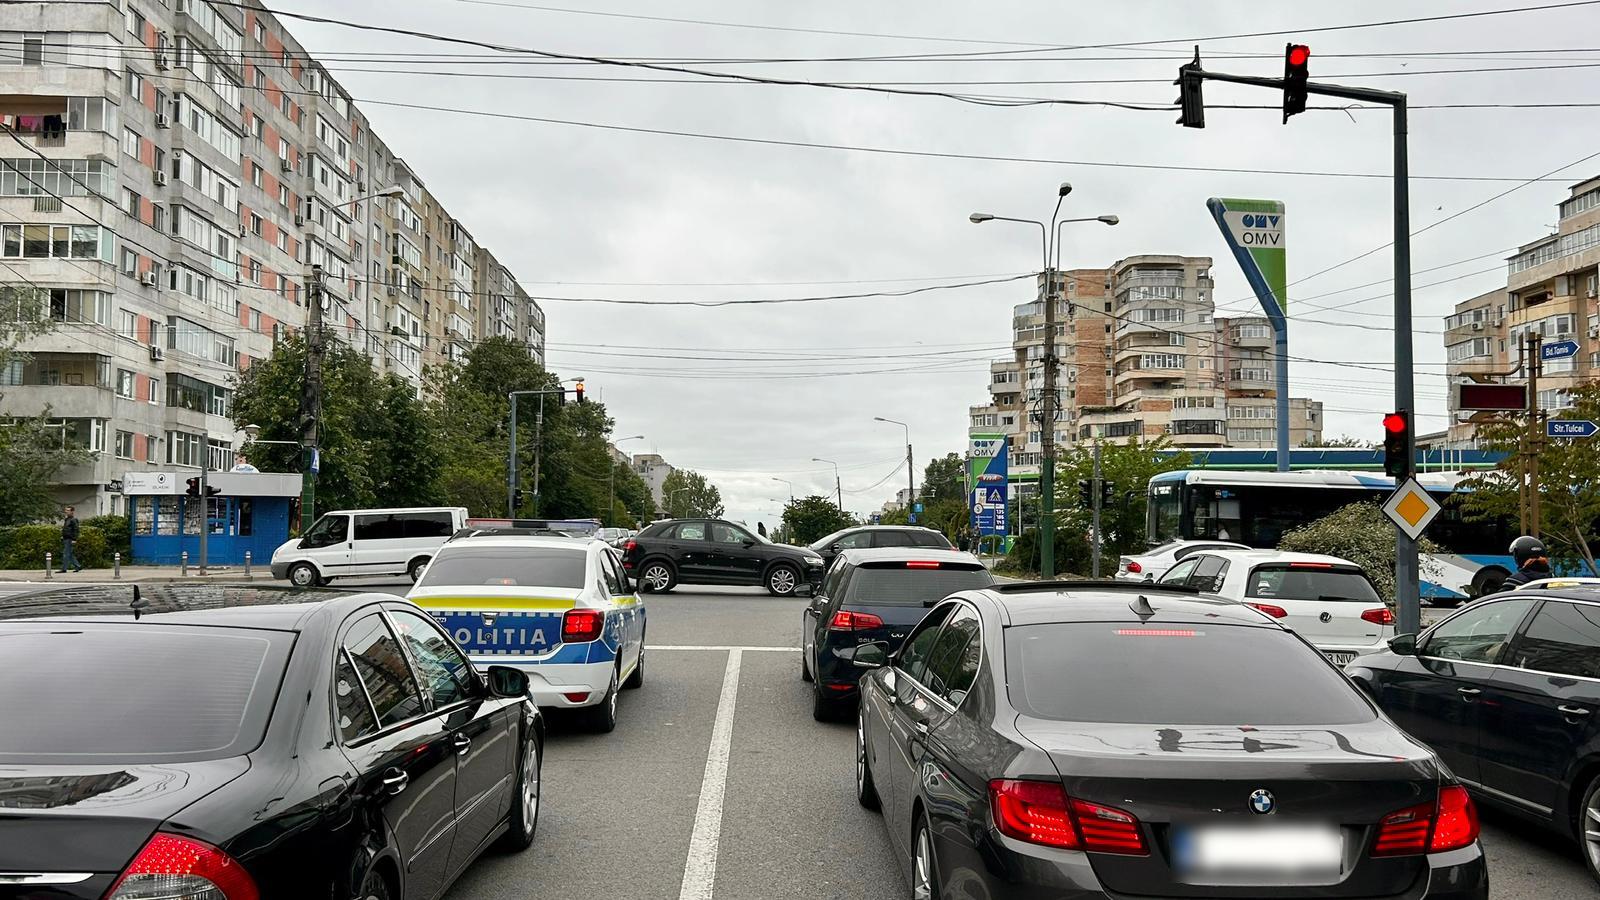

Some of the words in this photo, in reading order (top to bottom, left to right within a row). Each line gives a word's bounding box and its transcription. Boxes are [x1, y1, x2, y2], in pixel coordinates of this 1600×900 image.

[1243, 232, 1280, 245] OMV
[1545, 345, 1569, 357] Bd.Tomis
[1554, 424, 1585, 433] Str.Tulcei
[446, 628, 546, 645] OLITIA
